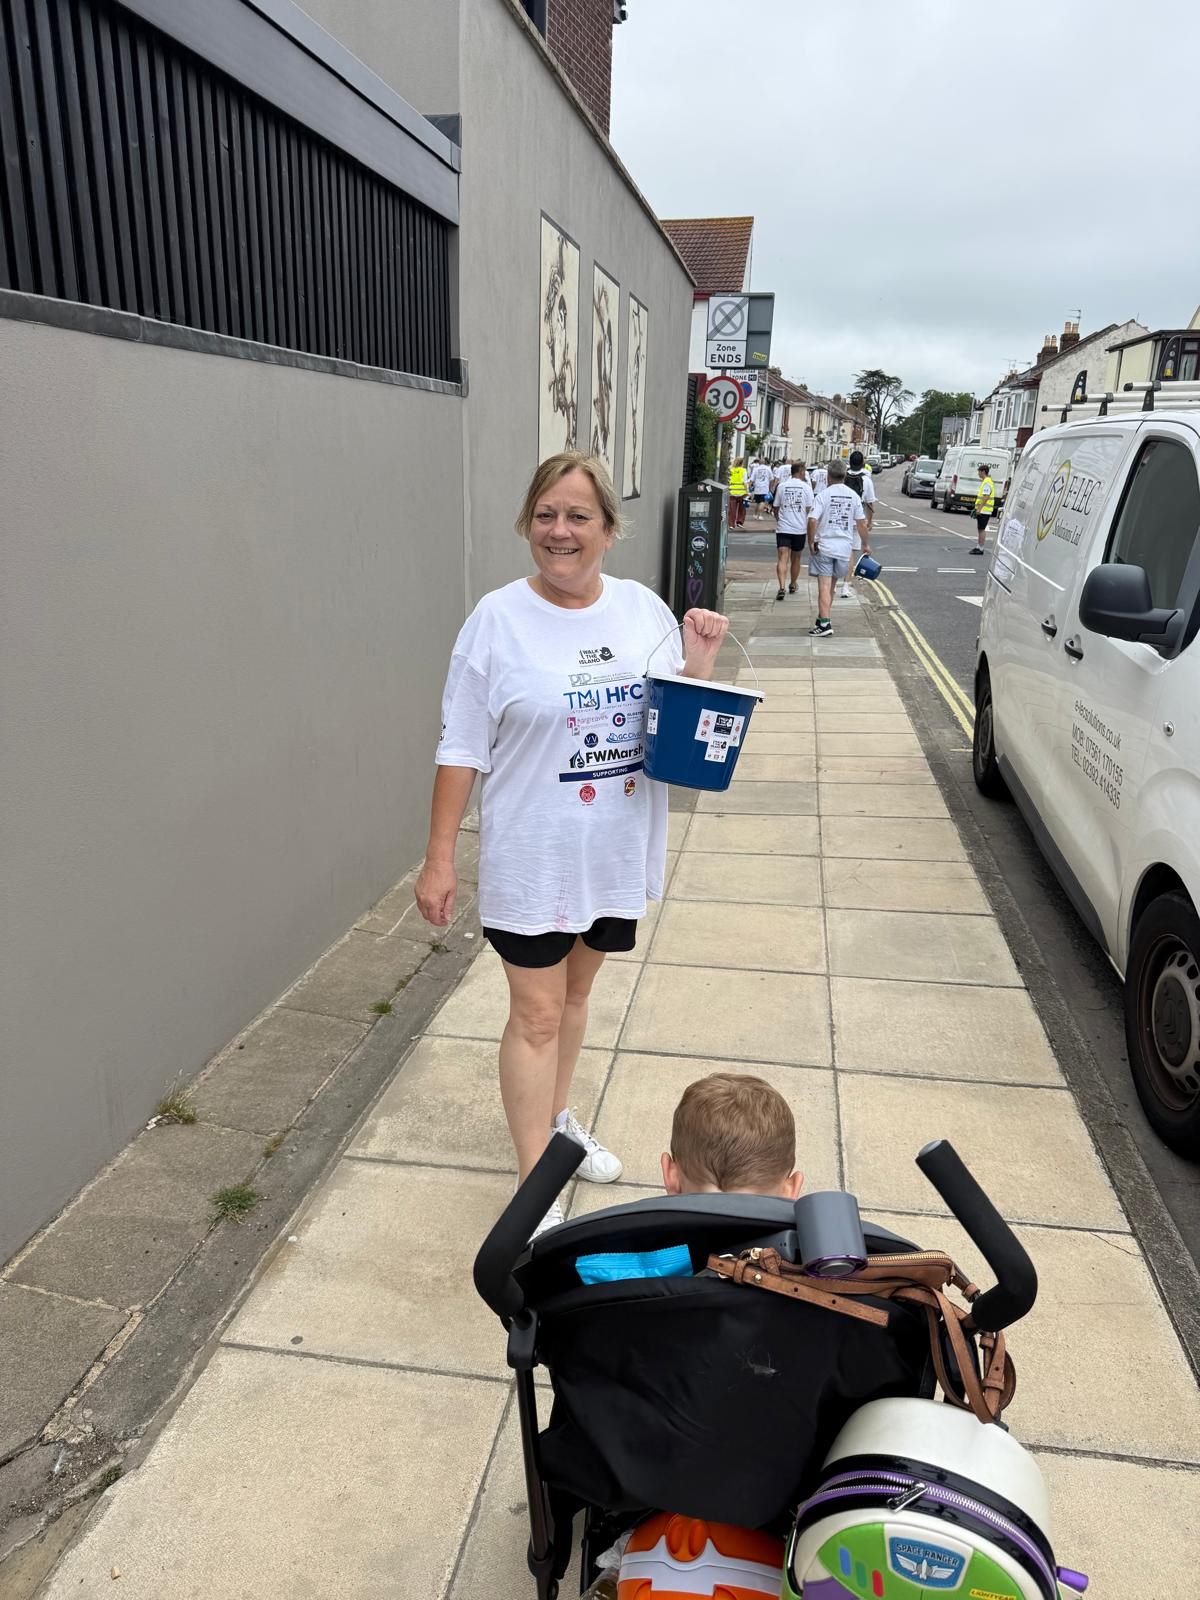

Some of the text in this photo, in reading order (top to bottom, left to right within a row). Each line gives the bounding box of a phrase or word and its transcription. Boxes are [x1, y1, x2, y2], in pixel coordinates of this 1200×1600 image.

[710, 354, 742, 363] ENDS
[707, 388, 738, 410] 30
[734, 414, 749, 424] 20
[1062, 475, 1102, 516] E-LEC
[605, 683, 644, 704] HFC
[592, 767, 628, 778] SUPPORTING
[1082, 756, 1099, 786] 02392
[1102, 753, 1124, 786] 170155
[896, 1543, 960, 1566] SPACE RANGER
